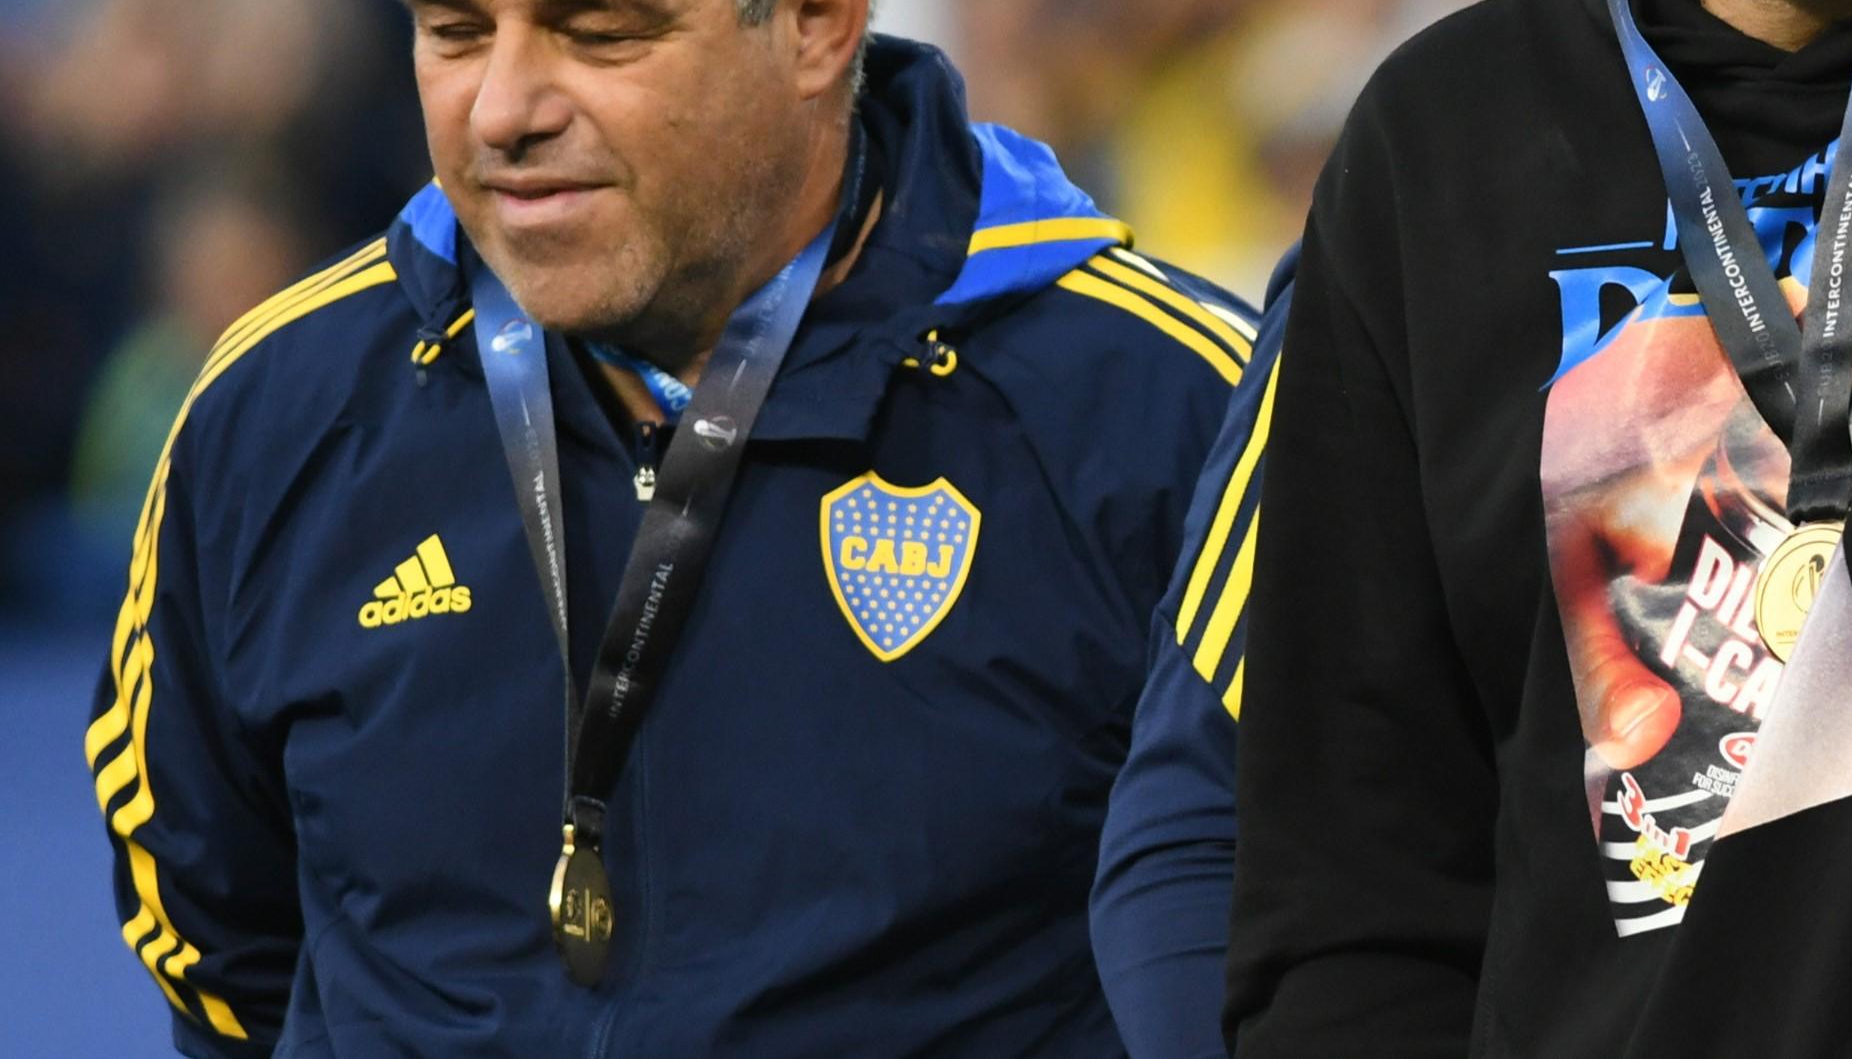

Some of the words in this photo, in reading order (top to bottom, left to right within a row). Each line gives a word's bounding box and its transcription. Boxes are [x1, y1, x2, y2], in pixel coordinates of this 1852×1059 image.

[1701, 186, 1764, 333] INTERCONTINENTAL
[358, 582, 471, 629] adidas
[840, 535, 955, 579] CABJ
[608, 560, 673, 719] INTERCONTINENTAL
